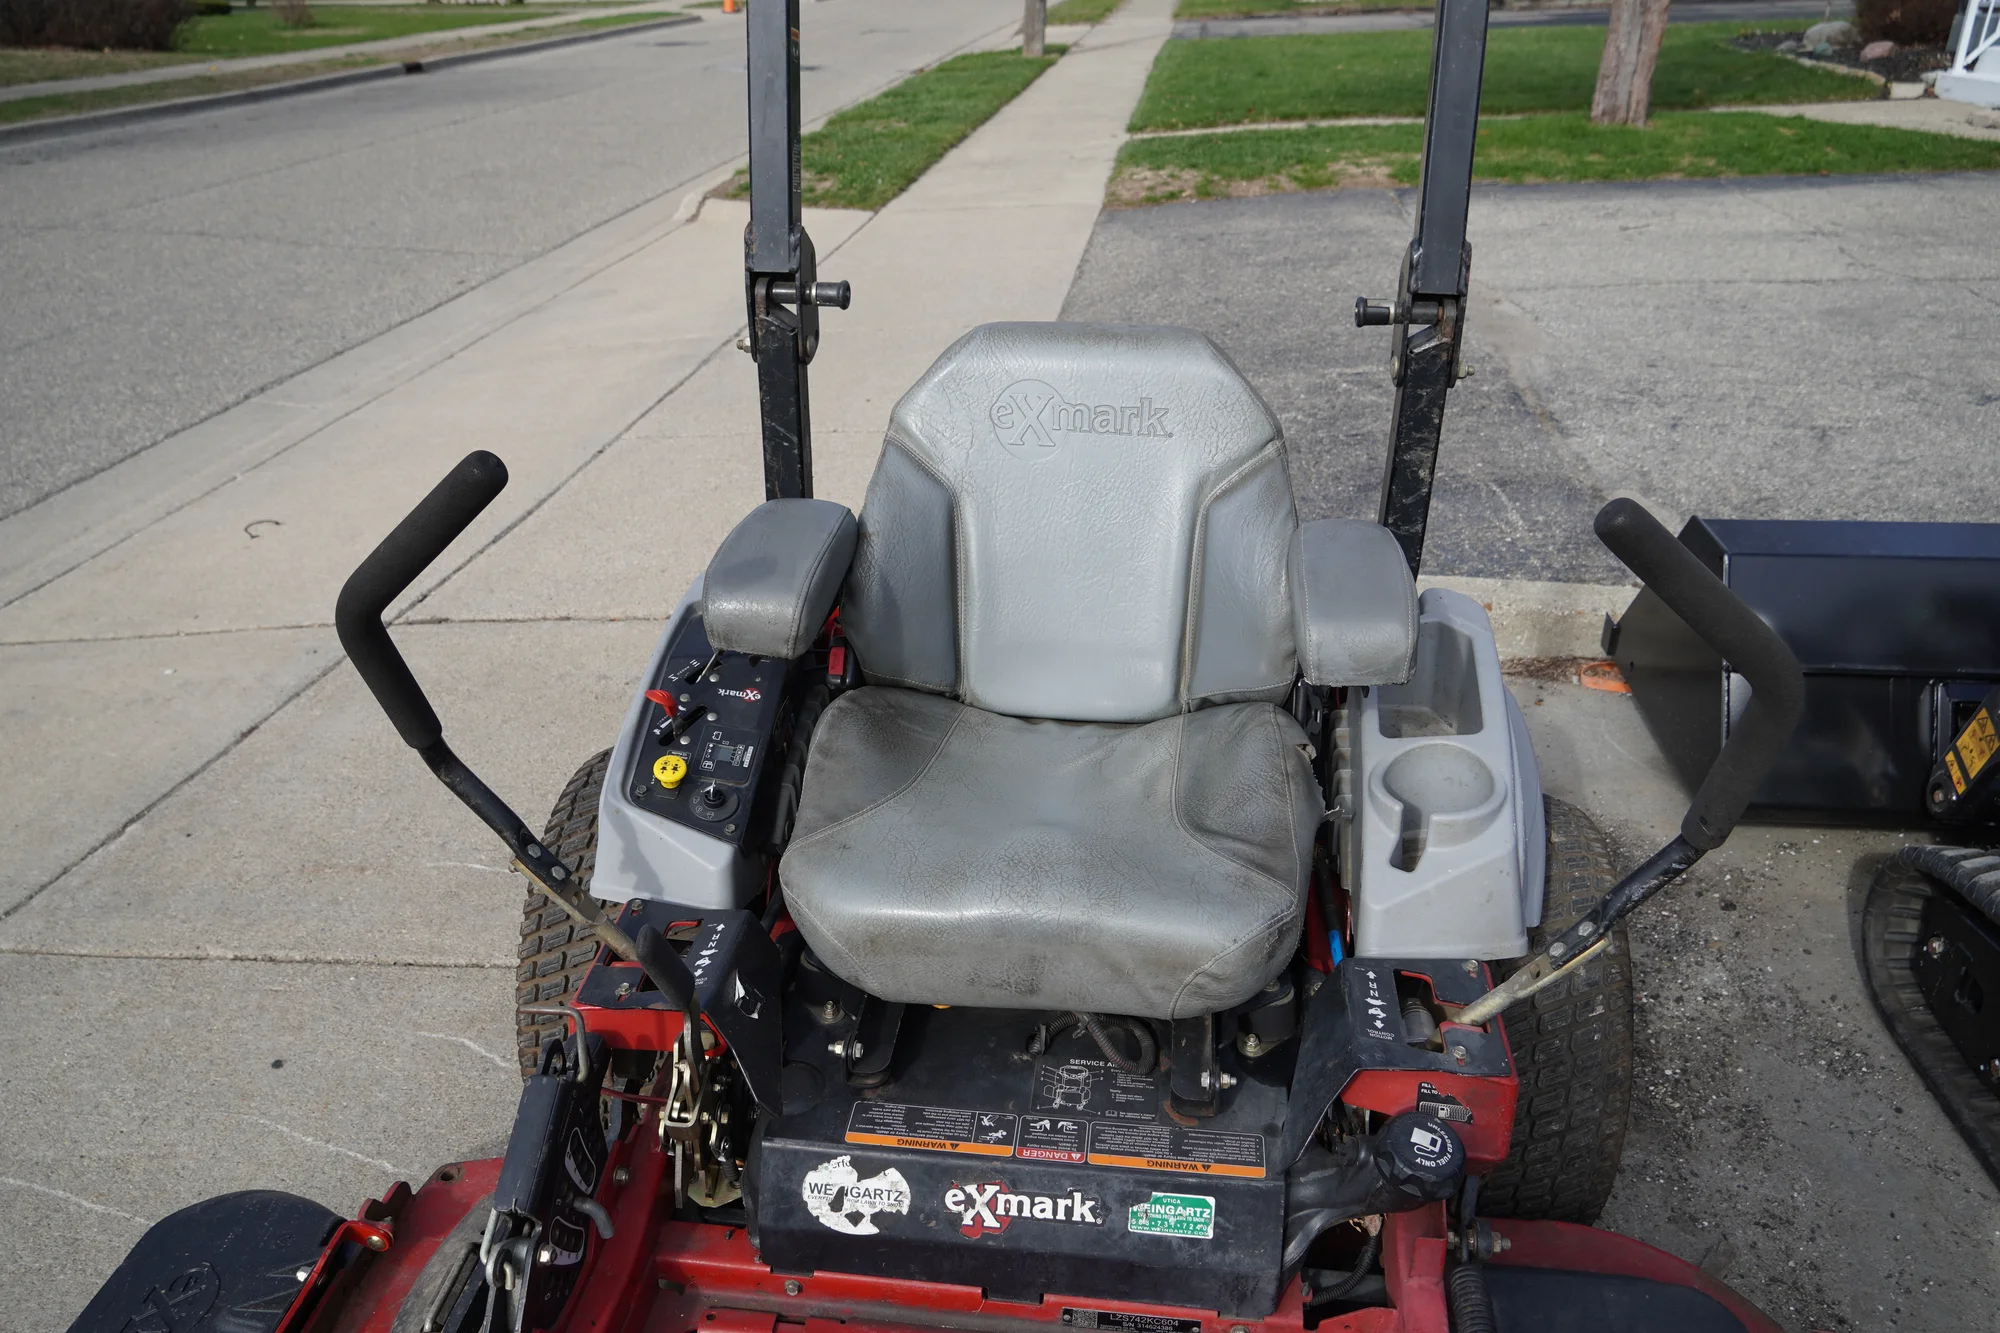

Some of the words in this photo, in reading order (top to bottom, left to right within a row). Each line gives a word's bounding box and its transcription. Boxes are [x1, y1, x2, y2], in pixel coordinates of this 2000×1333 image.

[1366, 1028, 1395, 1037] CONTROL
[1369, 1033, 1393, 1041] MOTION
[1069, 1058, 1105, 1067] SERVICE
[1427, 1122, 1453, 1153] UNLEADED
[896, 1138, 947, 1150] WARNING
[1022, 1149, 1068, 1160] DANGER
[1436, 1152, 1452, 1166] FUEL
[1147, 1160, 1199, 1171] WARNING
[1415, 1157, 1436, 1167] ONLY
[1133, 1203, 1211, 1218] WEINGARTZ
[1110, 1313, 1179, 1327] LZS742KC604
[1122, 1320, 1135, 1328] S/N
